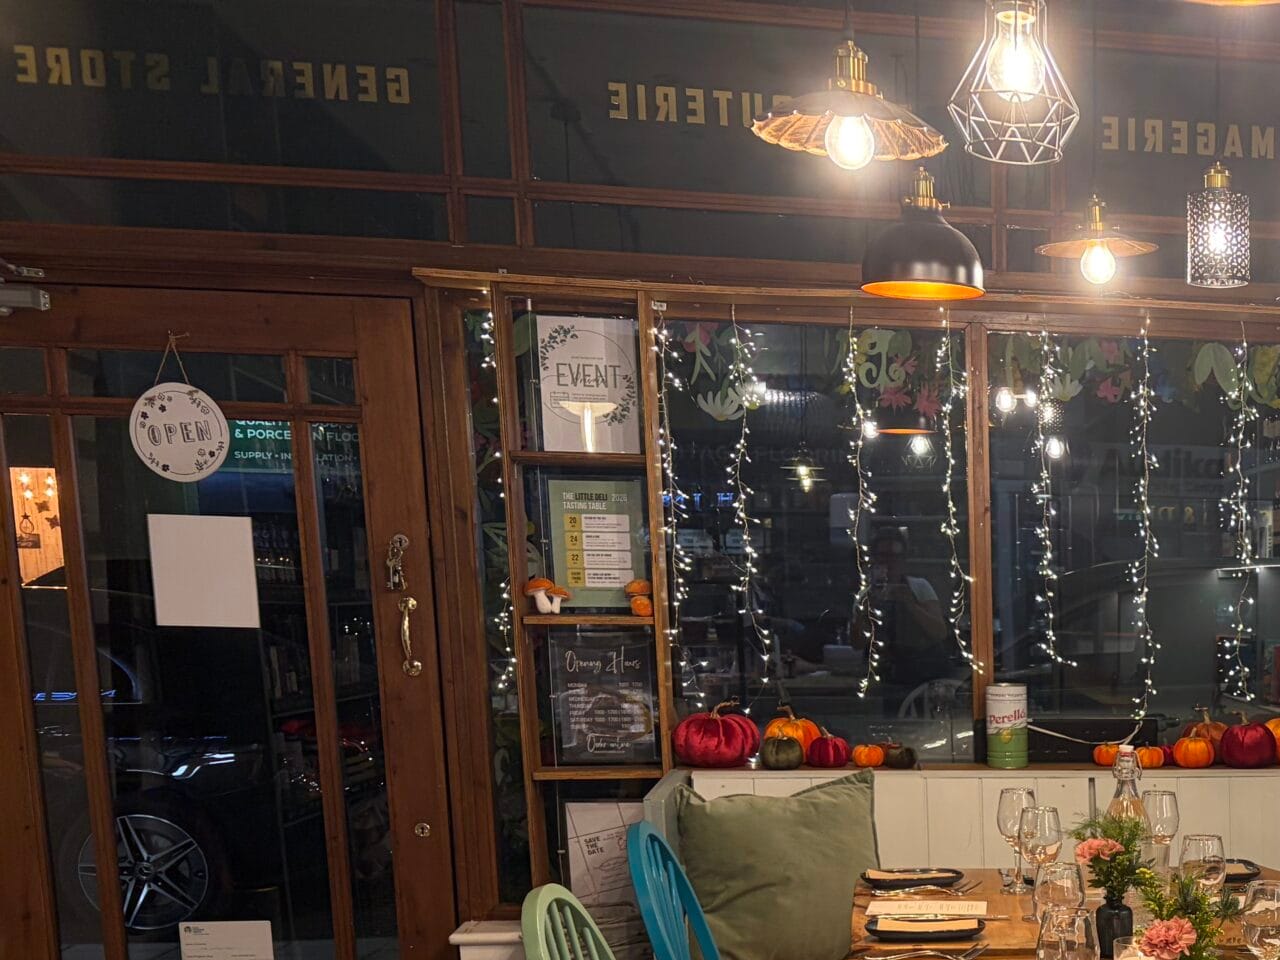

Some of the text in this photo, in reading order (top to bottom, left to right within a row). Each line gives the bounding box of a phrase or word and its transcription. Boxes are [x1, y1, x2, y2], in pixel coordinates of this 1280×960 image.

[556, 362, 621, 388] EVENT
[148, 420, 213, 446] OPEN
[234, 451, 272, 459] SUPPLY
[588, 502, 607, 510] TABLE
[565, 645, 641, 674] Opening Hours
[584, 836, 601, 844] SAVE
[587, 847, 604, 855] DATE
